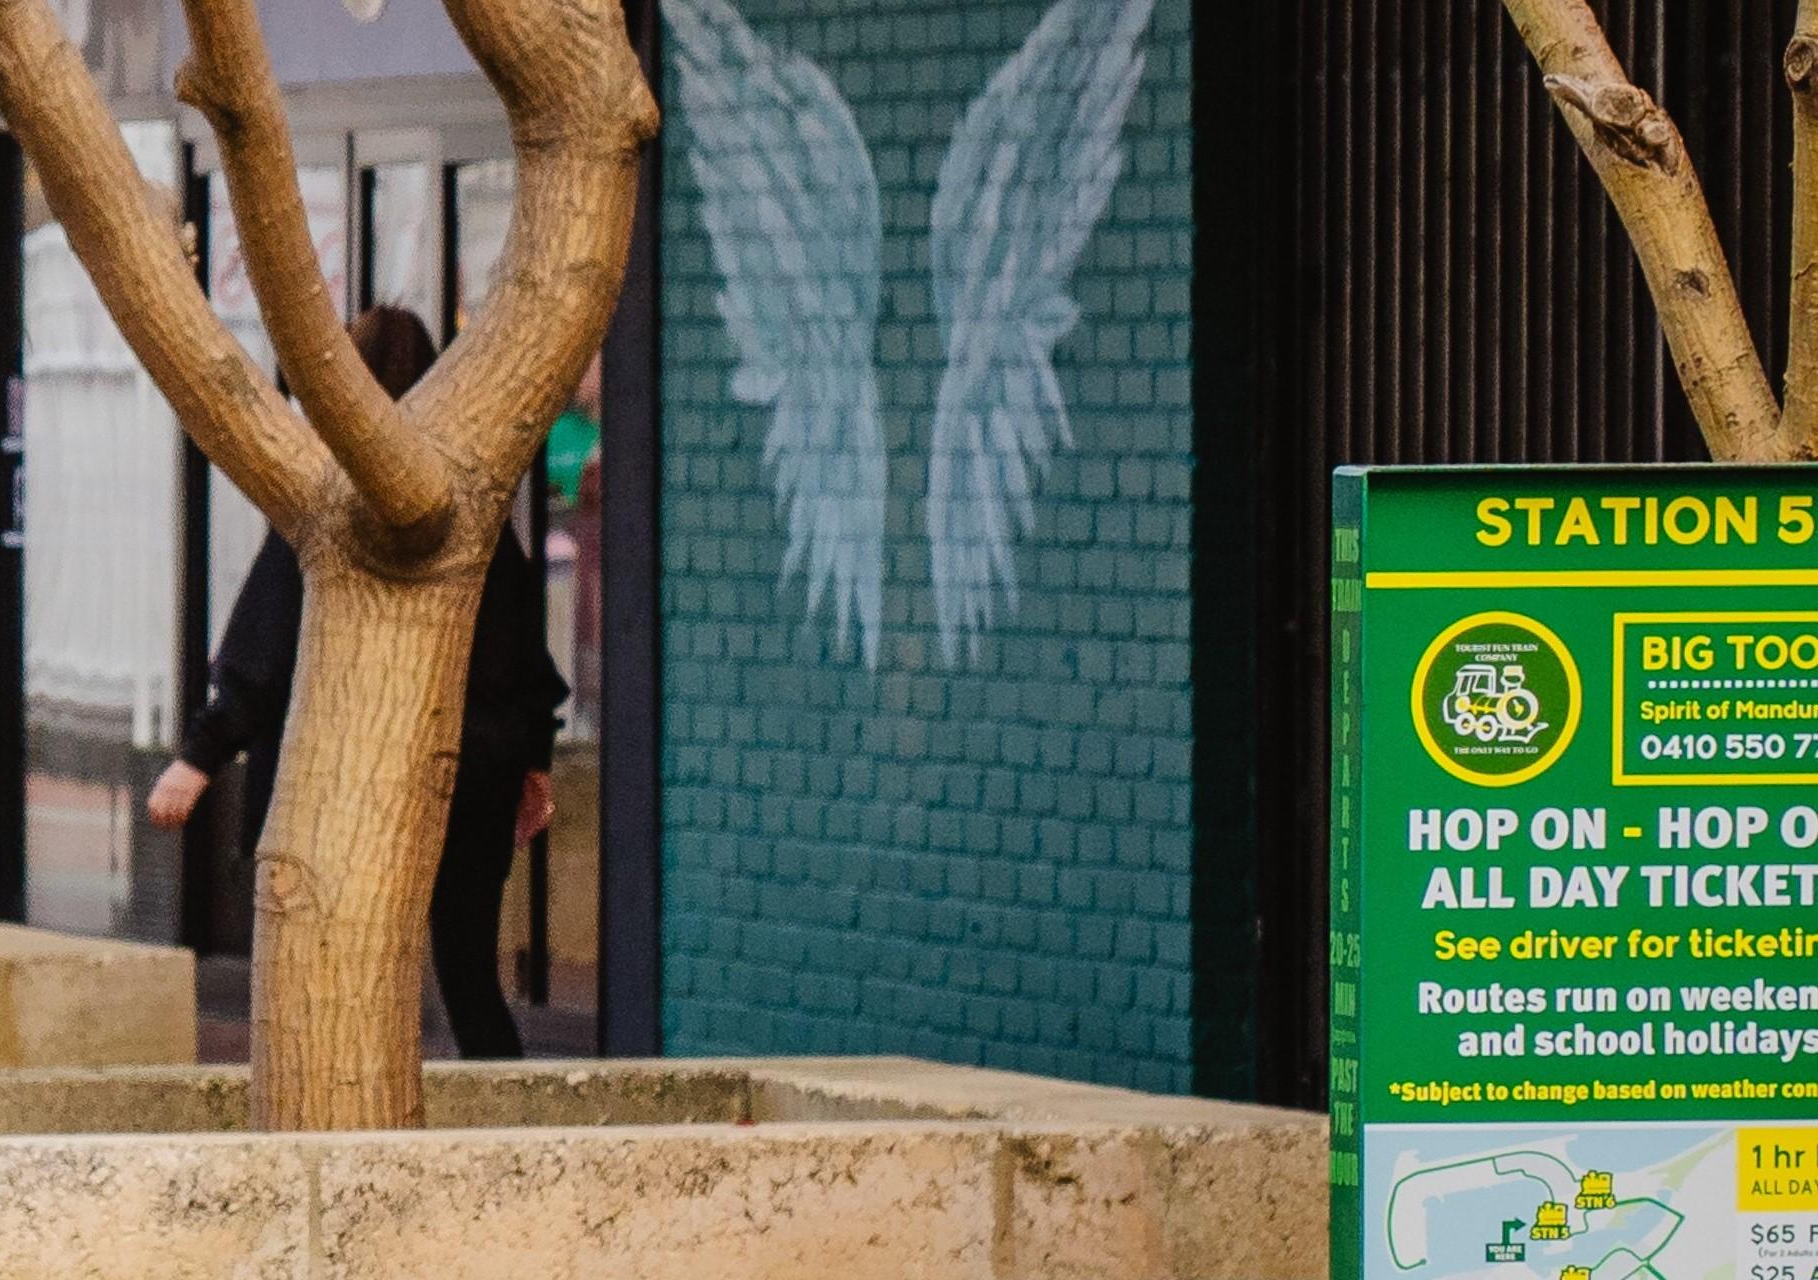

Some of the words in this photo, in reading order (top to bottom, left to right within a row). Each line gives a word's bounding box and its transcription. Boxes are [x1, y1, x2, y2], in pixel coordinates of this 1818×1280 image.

[1477, 496, 1757, 546] STATION
[1778, 496, 1814, 544] 5
[1335, 528, 1359, 563] THIS
[1332, 579, 1362, 612] TRAIN
[1455, 644, 1491, 652] TOURIST
[1492, 644, 1510, 652] FUN
[1513, 643, 1538, 652] TRAIN
[1643, 636, 1714, 670] BIG
[1727, 635, 1818, 669] TOO
[1641, 701, 1701, 724] Spirit
[1707, 701, 1730, 719] of
[1641, 735, 1717, 760] 0410
[1726, 734, 1785, 759] 550
[1794, 734, 1818, 758] 7
[1409, 809, 1519, 851] HOP
[1531, 808, 1606, 850] ON
[1659, 807, 1768, 848] HOP
[1422, 867, 1515, 908] ALL
[1530, 866, 1629, 908] DAY
[1330, 931, 1360, 968] 20-25
[1435, 931, 1501, 960] See
[1510, 930, 1618, 959] driver
[1628, 929, 1680, 958] for
[1419, 982, 1547, 1013] Routes
[1556, 988, 1616, 1012] run
[1627, 987, 1671, 1011] on
[1458, 1024, 1524, 1056] and
[1534, 1023, 1655, 1056] school
[1331, 1057, 1358, 1093] PAST
[1486, 1083, 1509, 1100] to
[1512, 1081, 1589, 1104] change
[1594, 1080, 1656, 1099] based
[1660, 1084, 1686, 1099] on
[1691, 1079, 1778, 1098] weather
[1753, 1145, 1761, 1168] 1
[1775, 1145, 1806, 1168] hr
[1751, 1180, 1783, 1195] ALL
[1751, 1223, 1795, 1244] $65
